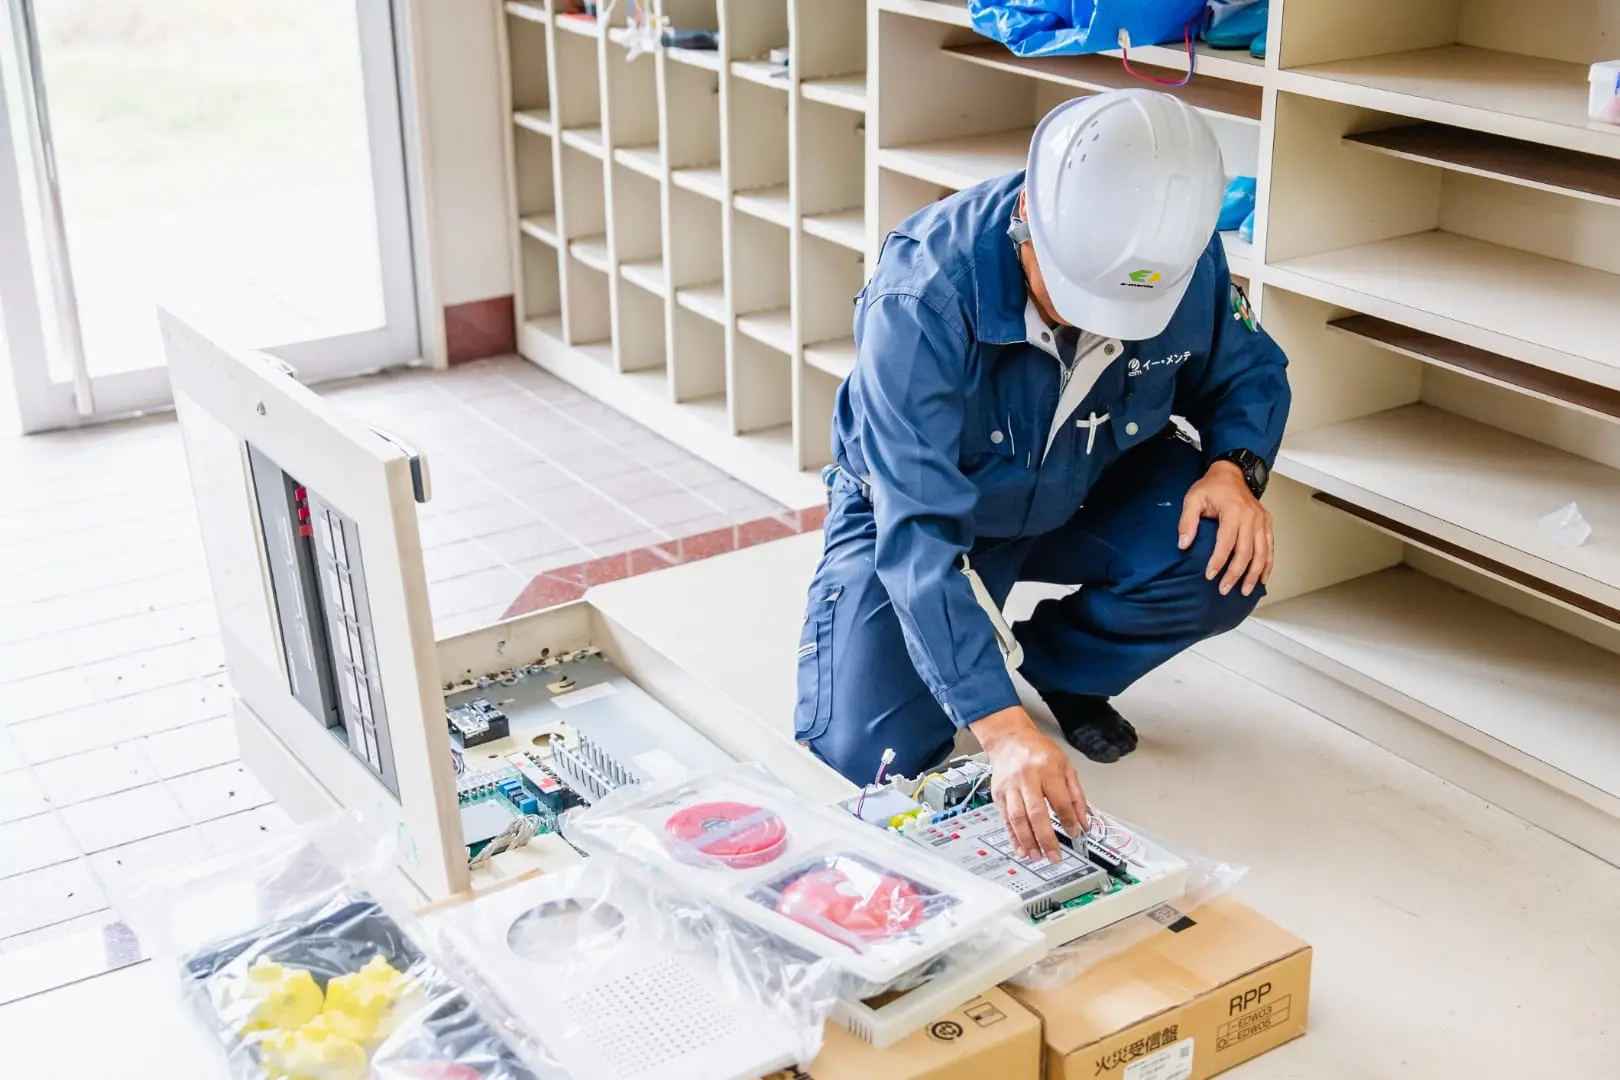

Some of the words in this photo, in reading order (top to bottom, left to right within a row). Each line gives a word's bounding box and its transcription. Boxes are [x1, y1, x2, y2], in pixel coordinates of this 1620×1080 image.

[1229, 982, 1271, 1016] RPP
[1094, 1024, 1179, 1077] 火災受信盤
